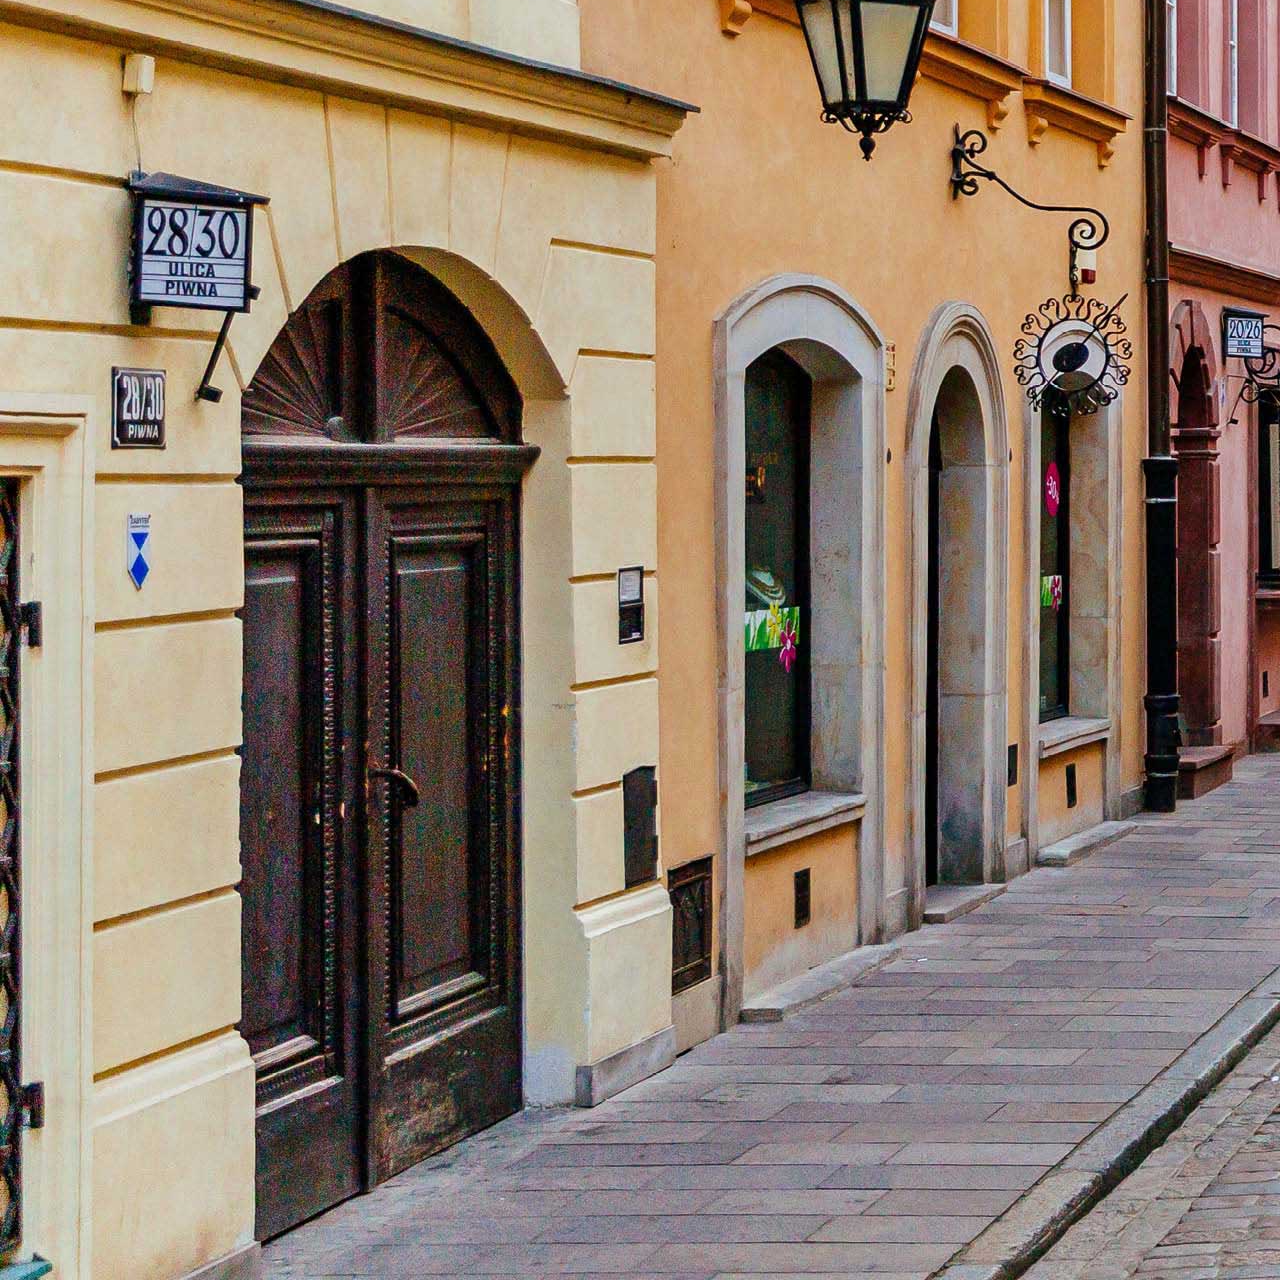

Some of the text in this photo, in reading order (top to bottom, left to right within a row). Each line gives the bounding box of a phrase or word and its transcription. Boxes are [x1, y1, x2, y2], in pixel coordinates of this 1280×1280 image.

[168, 261, 216, 278] ULICA
[165, 280, 218, 297] PIWNA
[123, 375, 164, 421] 28/30
[128, 424, 159, 438] PIWNA
